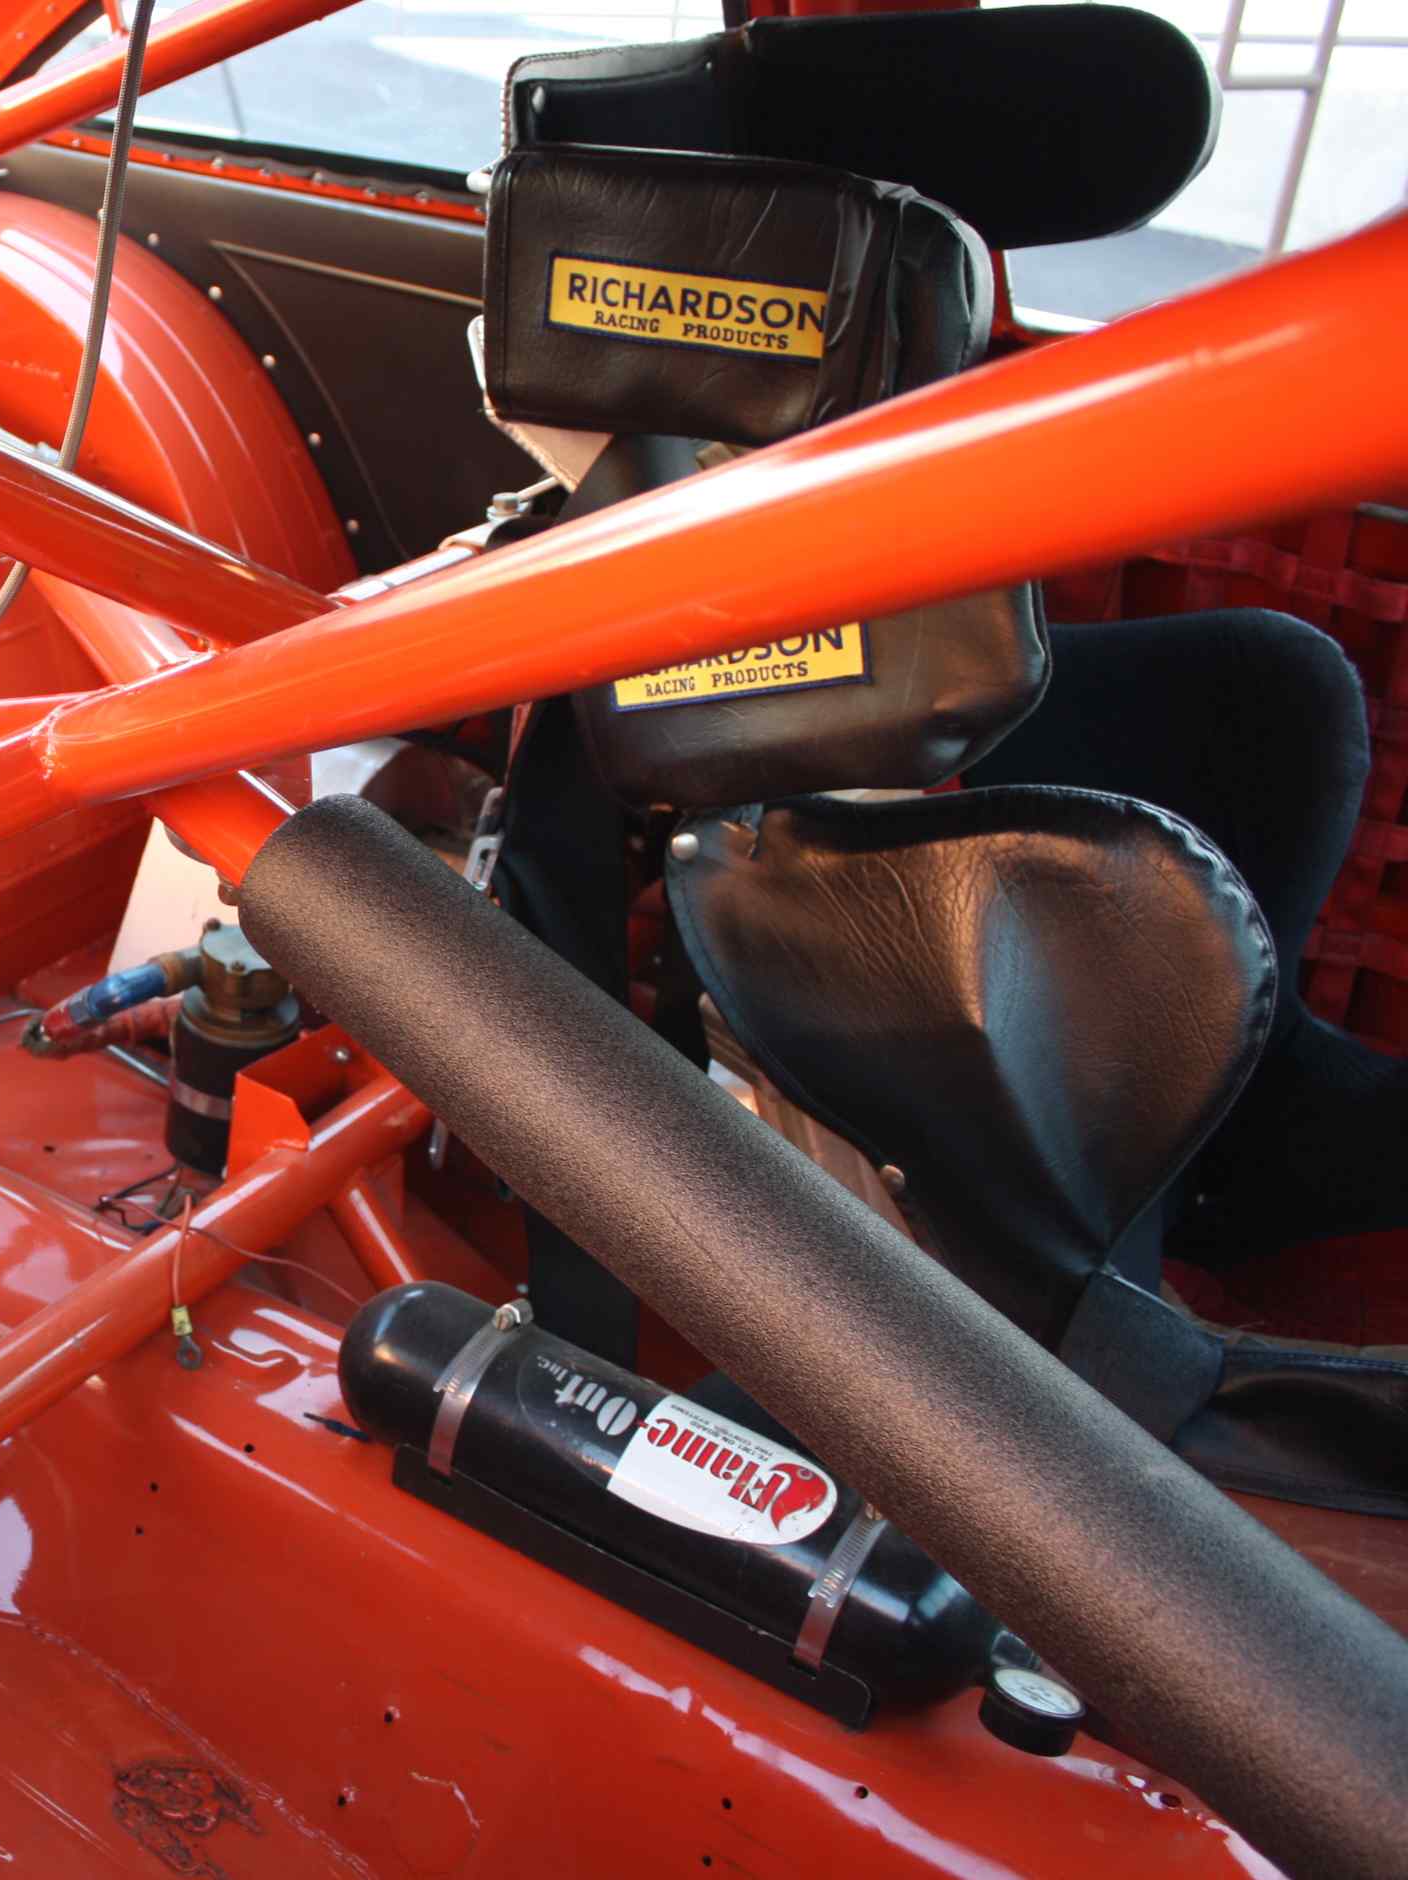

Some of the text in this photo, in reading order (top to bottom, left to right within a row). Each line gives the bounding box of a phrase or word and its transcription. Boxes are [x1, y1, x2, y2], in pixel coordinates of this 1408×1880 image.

[568, 272, 827, 332] RICHARDSON
[593, 310, 789, 350] RACING PRODUCTS
[645, 660, 809, 697] RACING PRODUCTS
